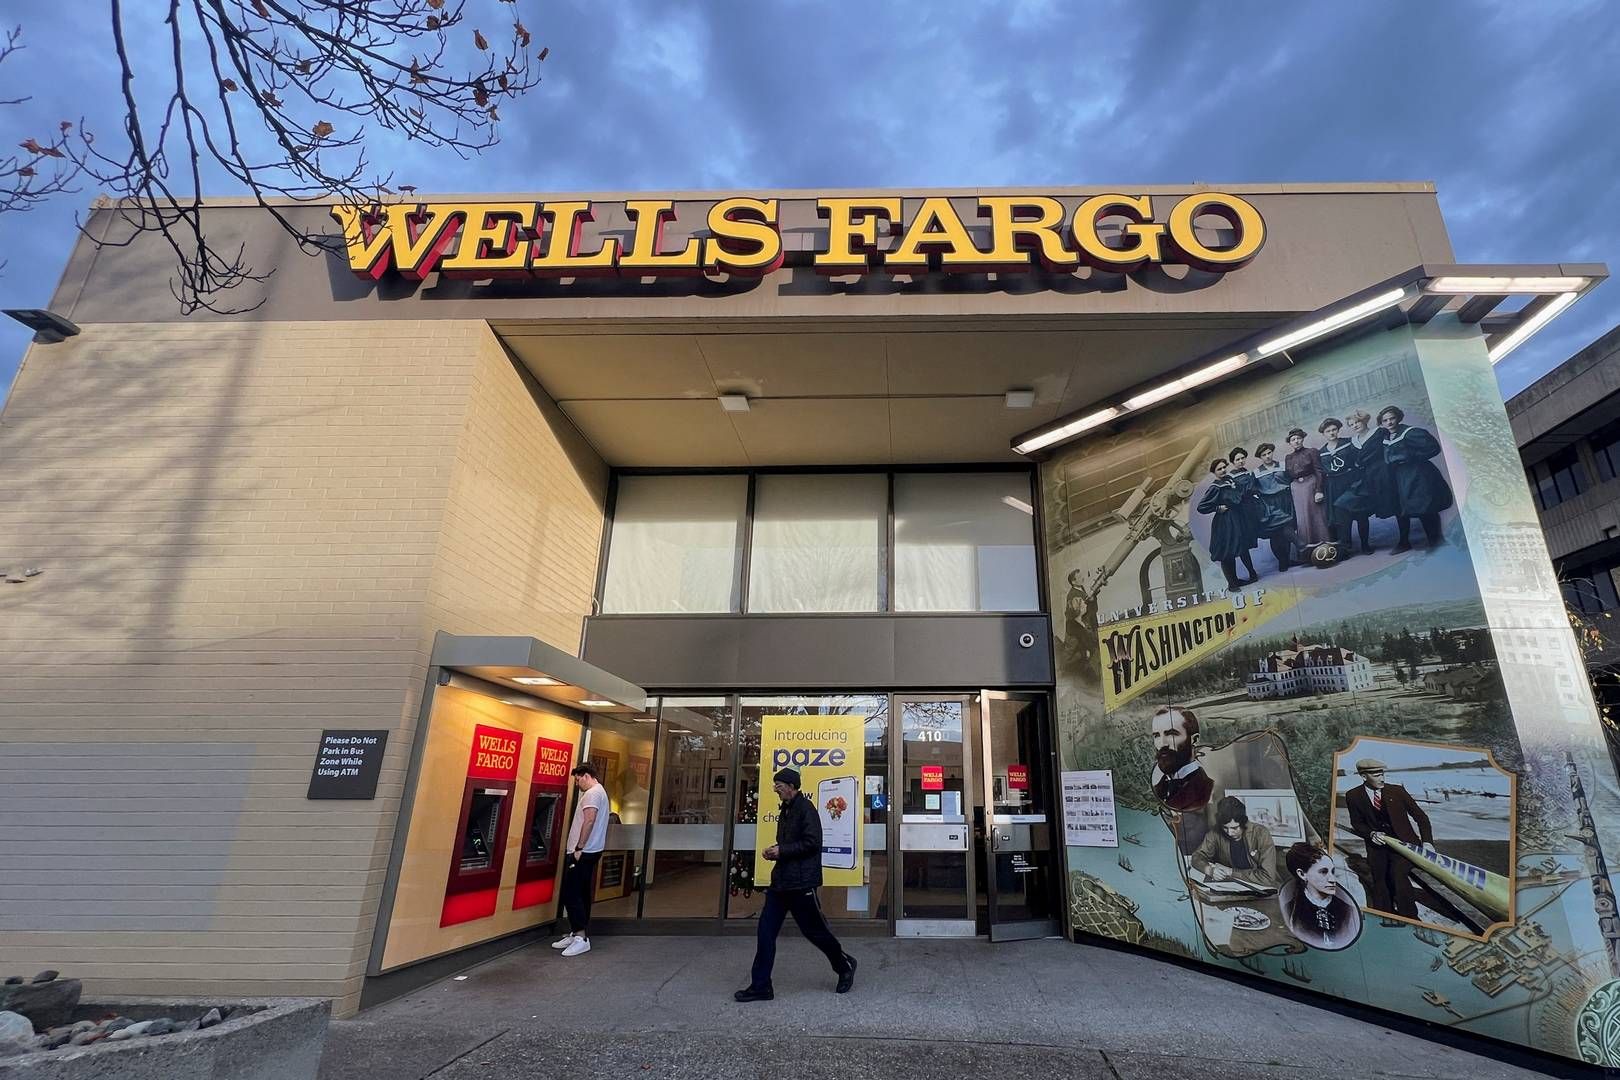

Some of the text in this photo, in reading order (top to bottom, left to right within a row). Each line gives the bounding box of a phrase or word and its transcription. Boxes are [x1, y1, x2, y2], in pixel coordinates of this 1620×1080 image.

[330, 192, 1266, 272] WELLS FARGO
[1097, 588, 1265, 624] UNIVERSITY OF
[1102, 611, 1236, 695] WASHINGTON
[325, 736, 377, 744] Please Do Not
[479, 734, 516, 754] WELLS
[774, 729, 848, 743] Introducing
[917, 730, 942, 742] 410
[322, 747, 364, 755] Park in Bus
[541, 746, 569, 763] WELLS
[320, 757, 363, 765] Zone While
[475, 752, 514, 770] FARGO
[773, 748, 846, 772] paze
[318, 768, 359, 777] Using ATM
[538, 762, 567, 777] FARGO
